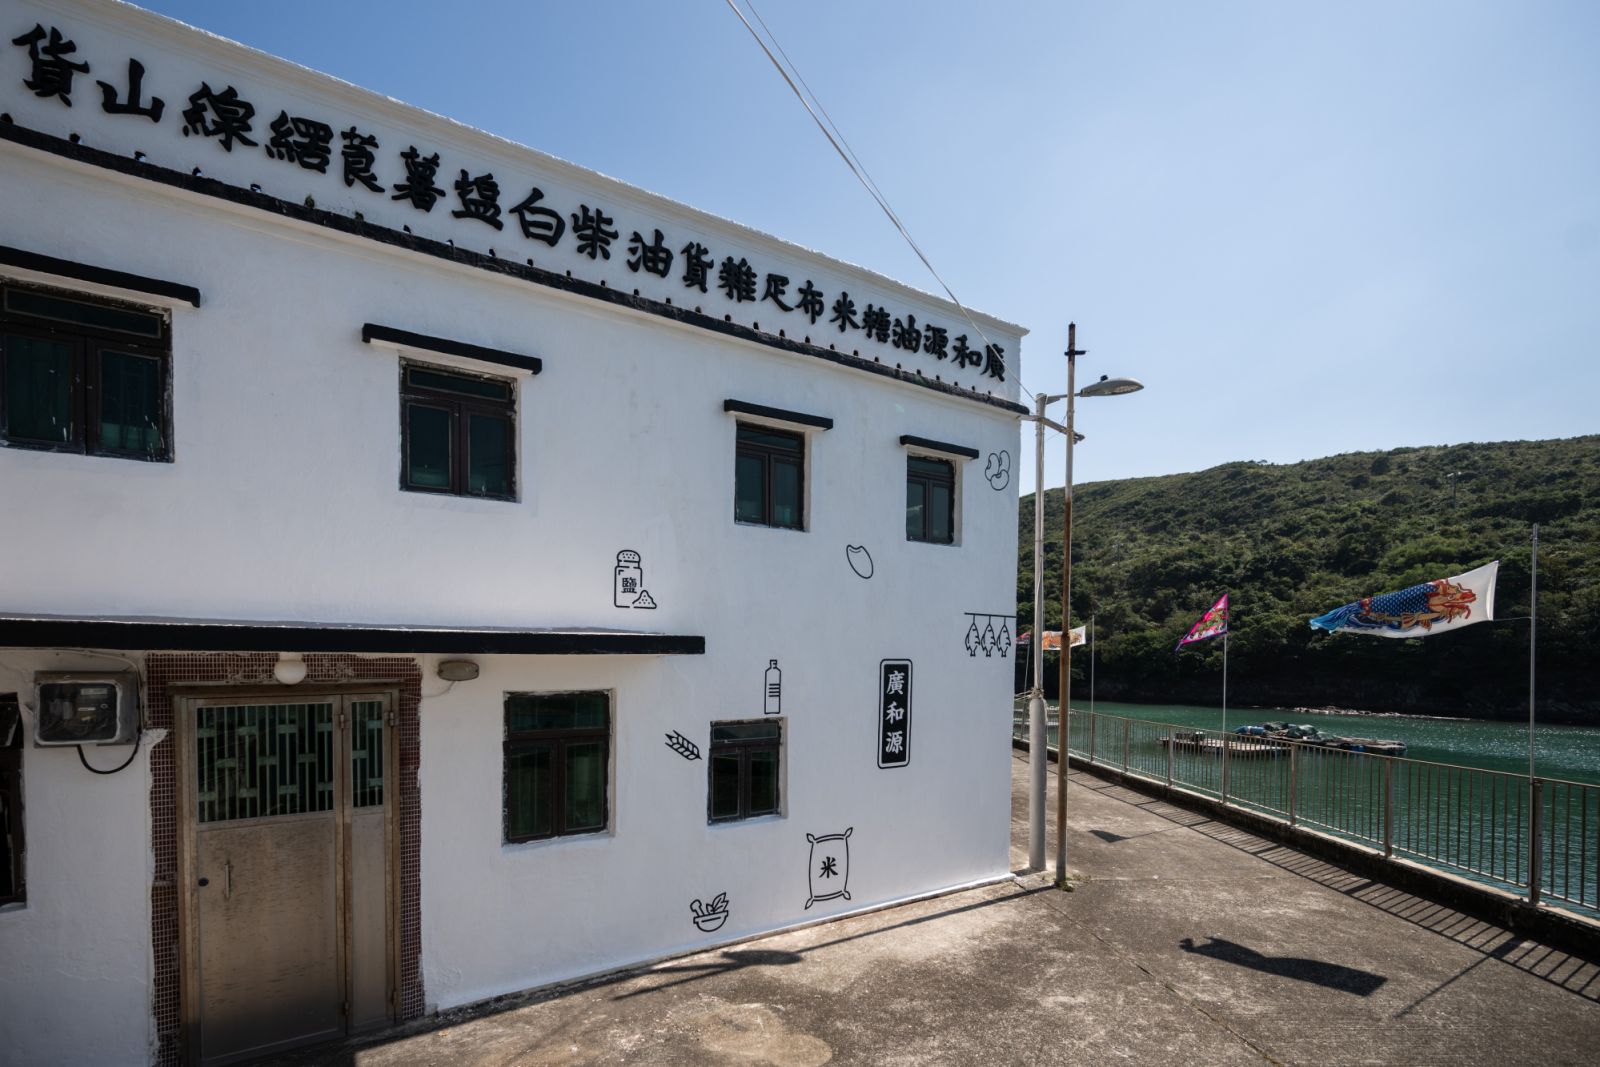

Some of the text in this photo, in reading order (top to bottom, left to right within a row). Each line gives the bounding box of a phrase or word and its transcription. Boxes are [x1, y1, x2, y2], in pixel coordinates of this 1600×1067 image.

[621, 577, 638, 594] 鹽
[885, 670, 905, 754] 廣和源
[819, 856, 838, 879] 米
